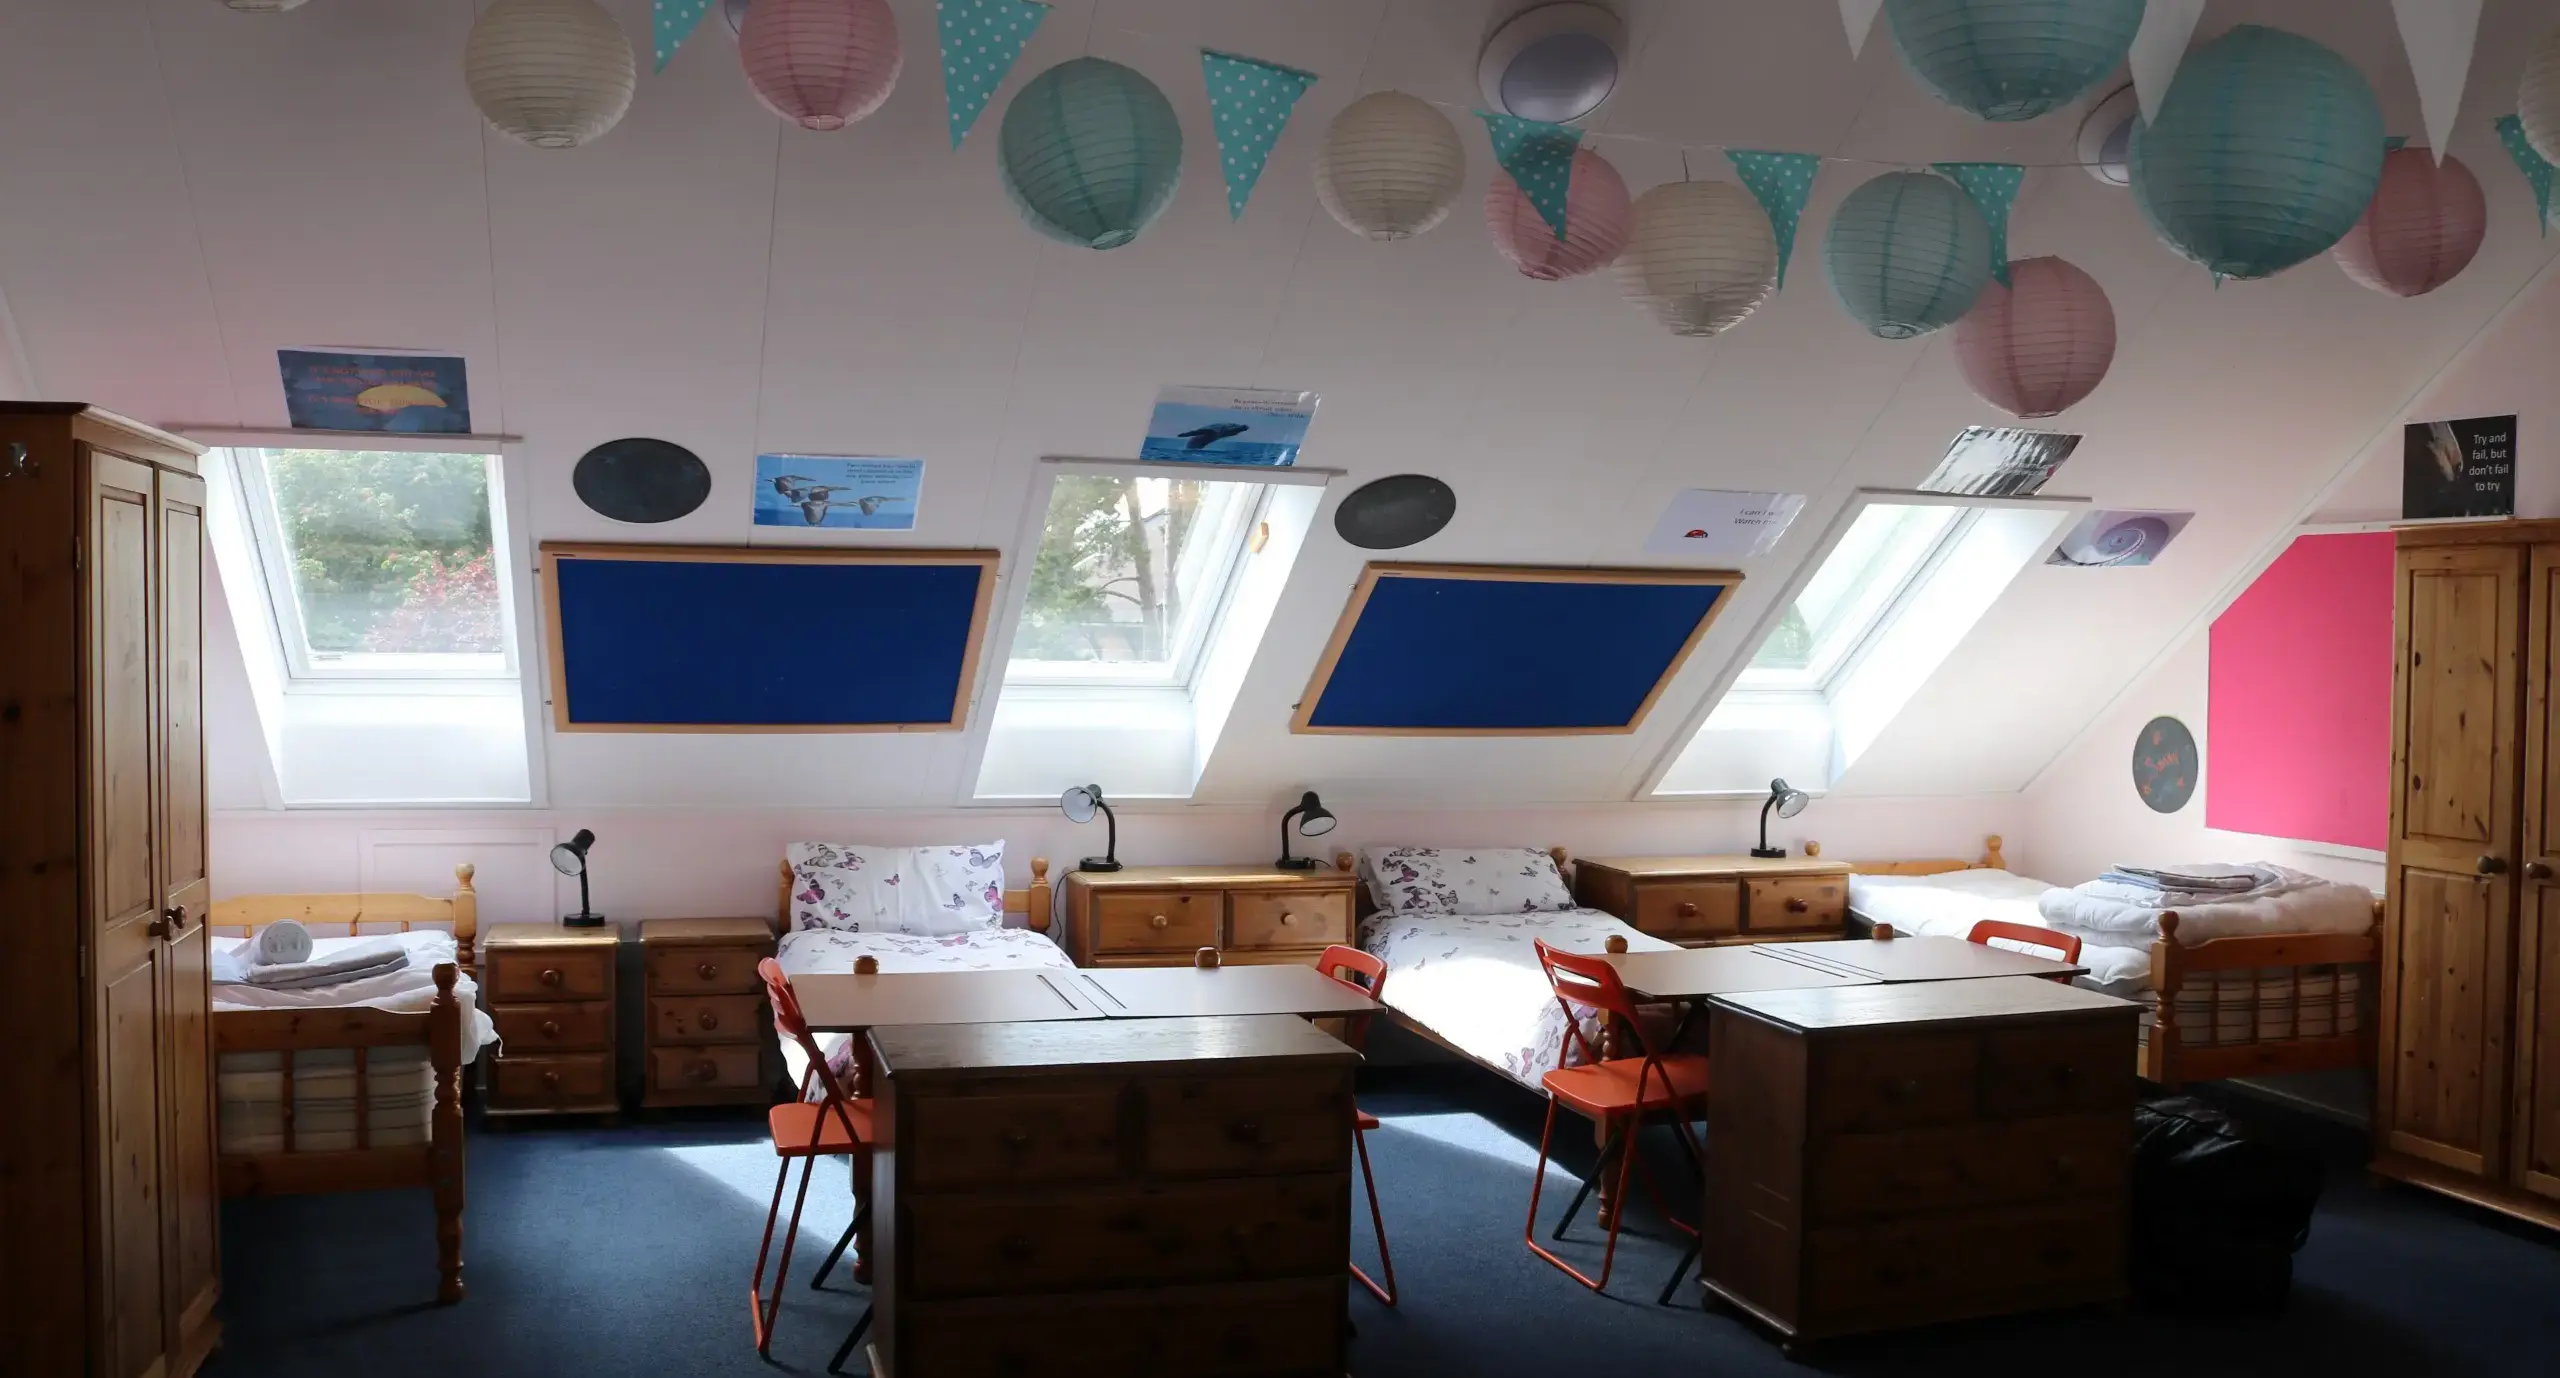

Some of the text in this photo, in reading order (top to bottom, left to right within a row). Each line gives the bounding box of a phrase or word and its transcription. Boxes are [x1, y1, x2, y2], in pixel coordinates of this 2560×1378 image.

[2473, 432, 2507, 446] Try and
[2472, 449, 2507, 460] fail, but
[2469, 464, 2509, 476] don't fail
[2475, 481, 2500, 492] to try
[1733, 517, 1762, 525] Watch
